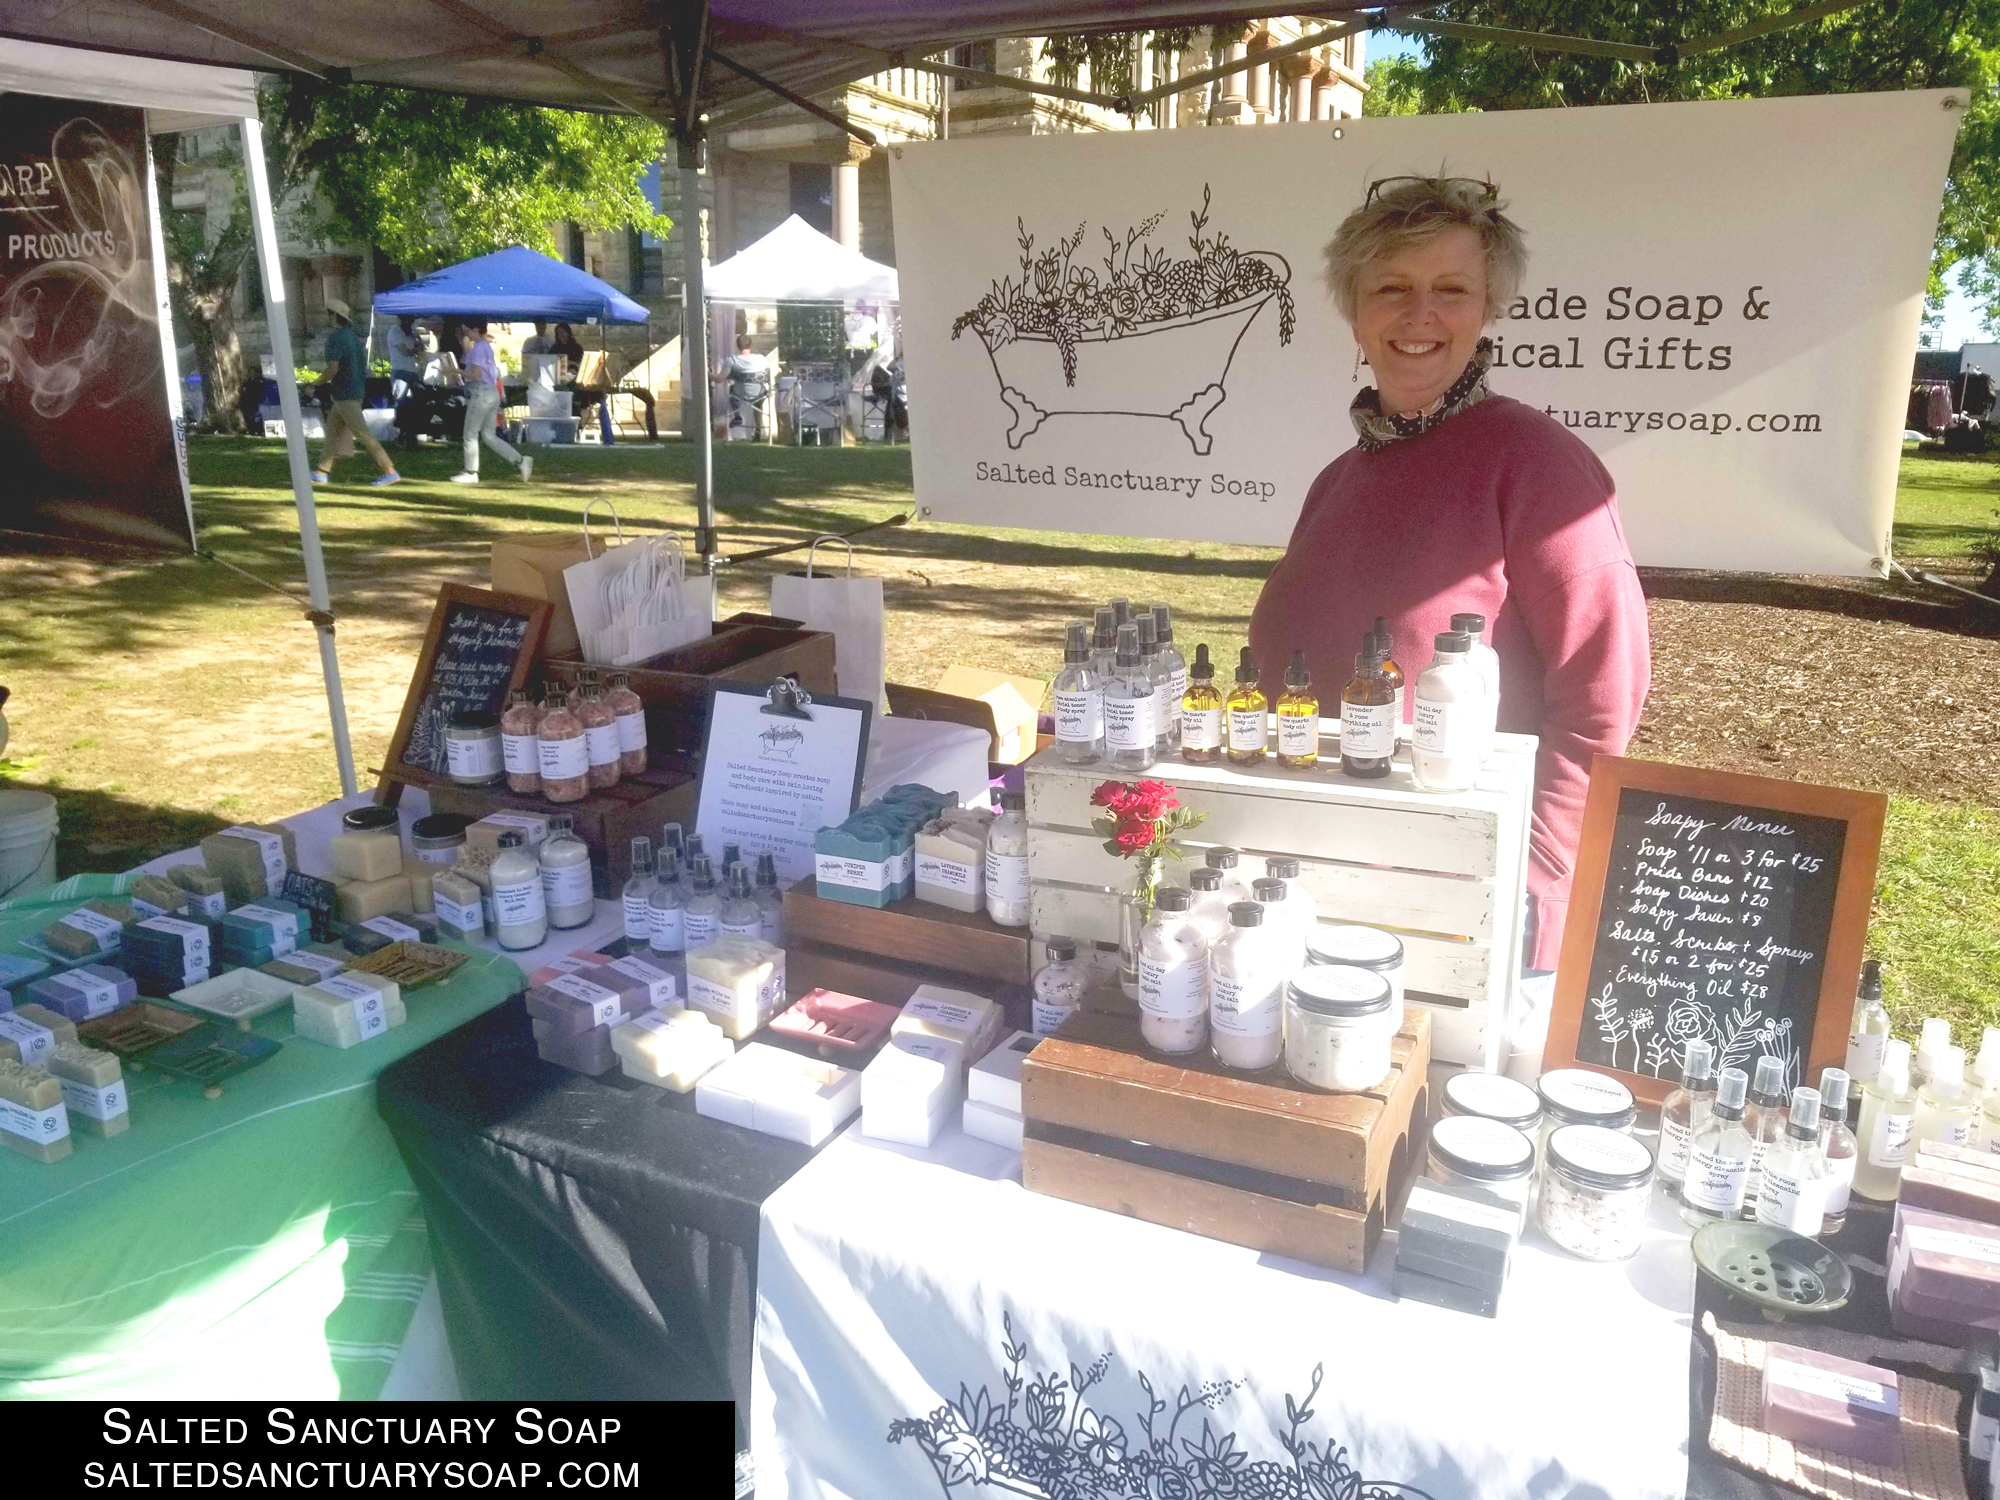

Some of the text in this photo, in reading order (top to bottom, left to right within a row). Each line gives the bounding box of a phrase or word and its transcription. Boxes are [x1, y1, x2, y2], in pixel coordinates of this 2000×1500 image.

[8, 230, 115, 259] PRODUCTS
[1506, 285, 1770, 326] ade Soap &
[1491, 335, 1732, 371] ical Gifts
[1540, 404, 1823, 435] tuarysoap.com
[976, 461, 1276, 502] Salted Sanctuary Soap
[1346, 705, 1373, 713] lavender
[727, 762, 831, 785] Salted Sanctuary Soap creates soap
[743, 773, 756, 783] body
[772, 779, 786, 787] with
[787, 780, 801, 788] skin
[802, 783, 824, 793] loving
[728, 781, 824, 802] ingredients inspired by nature.
[1645, 803, 1795, 841] Soapy Menu
[1637, 838, 1677, 861] Soap
[1715, 852, 1730, 863] or
[1741, 850, 1753, 865] 3
[1759, 850, 1785, 868] for
[1791, 852, 1824, 872] $25
[844, 862, 867, 870] JUNIPER
[941, 862, 963, 871] LAVENDER
[1635, 861, 1683, 880] Pride
[1691, 868, 1733, 885] Bars
[1631, 880, 1670, 907] Soap
[1678, 885, 1730, 904] Dishes
[1628, 900, 1678, 930] Soapy
[1742, 913, 1761, 927] $8
[1665, 955, 1680, 966] or
[1688, 955, 1700, 968] 2
[1706, 957, 1733, 974] for
[1738, 958, 1769, 977] $25
[1616, 965, 1768, 1000] Everything Oil $28
[1664, 1128, 1683, 1142] energy
[1670, 1124, 1684, 1135] read
[1692, 1155, 1712, 1171] energy
[1699, 1152, 1714, 1163] read
[1715, 1158, 1727, 1166] the
[1708, 1171, 1729, 1180] spray
[1767, 1170, 1796, 1187] the room
[1763, 1183, 1780, 1195] spray
[1767, 1179, 1801, 1195] cleansing
